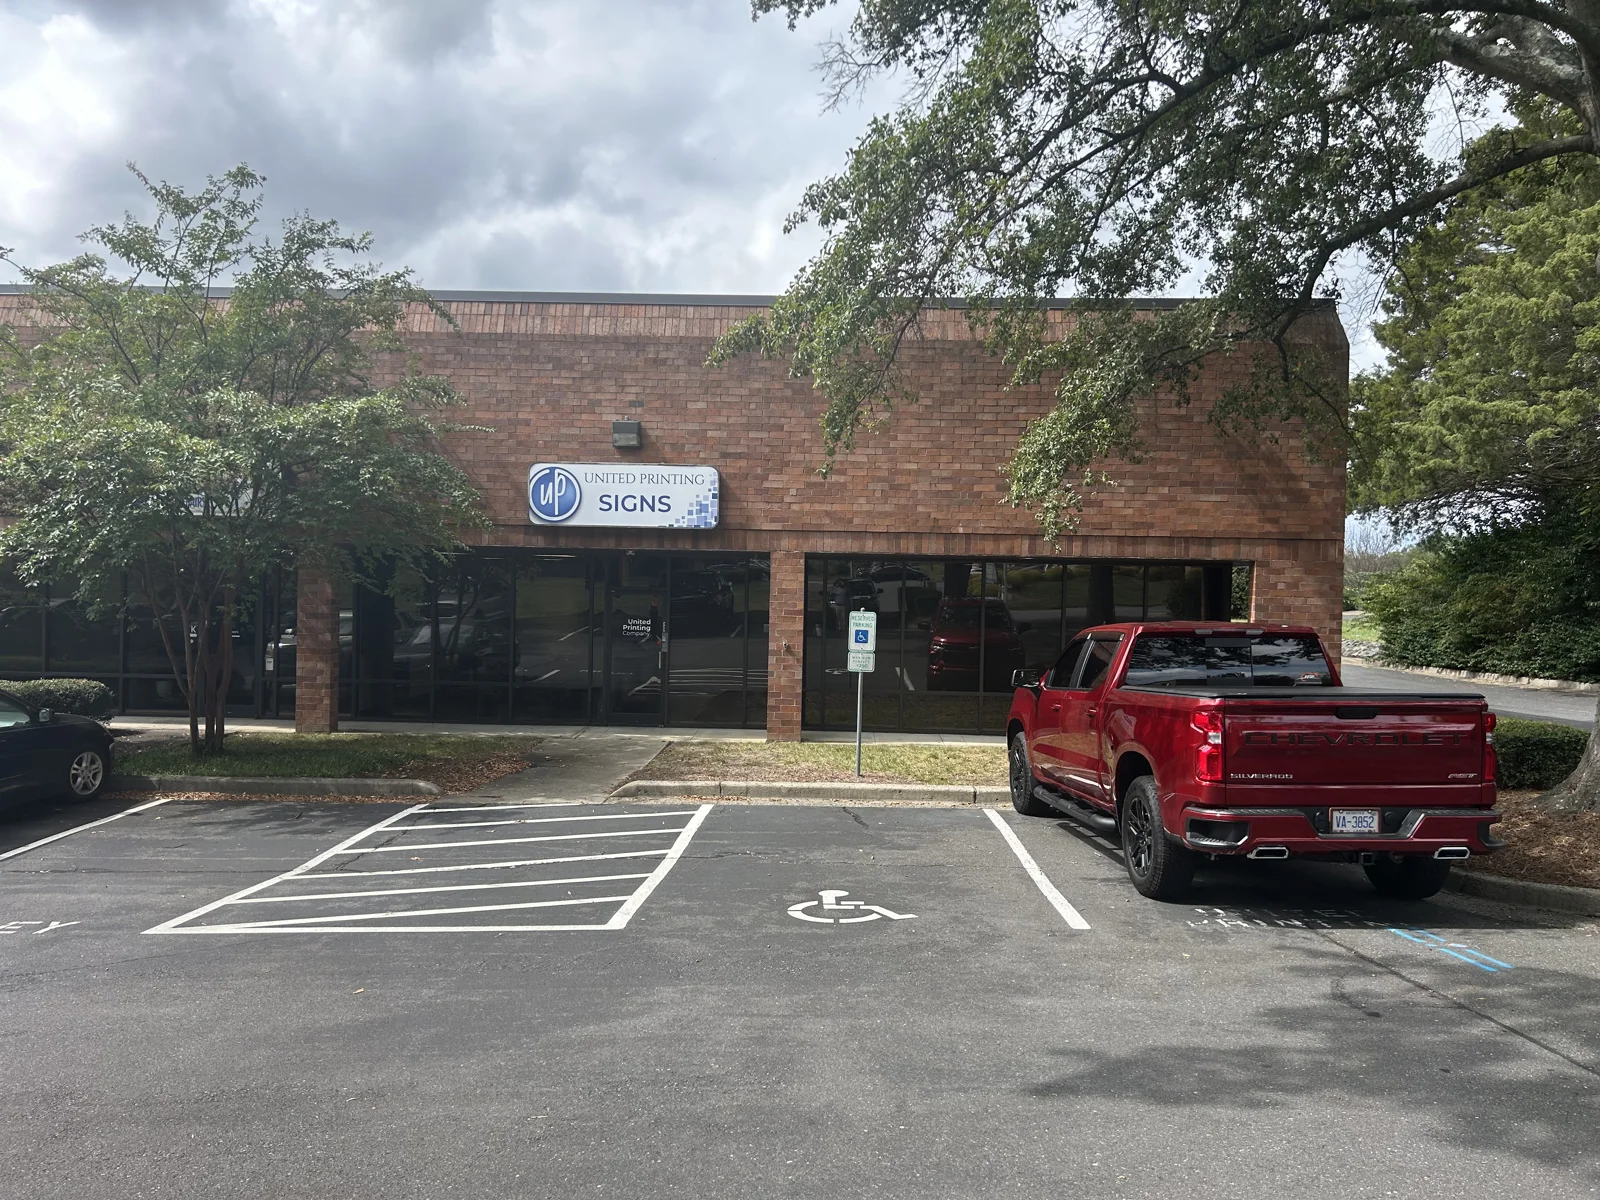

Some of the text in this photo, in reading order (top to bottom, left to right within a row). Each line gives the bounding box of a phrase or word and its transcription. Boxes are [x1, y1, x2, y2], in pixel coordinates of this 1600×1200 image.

[584, 472, 705, 486] UNITED PRINTING
[598, 494, 672, 513] SIGNS
[1245, 732, 1468, 746] CHEVROLET
[1335, 815, 1375, 829] VA-3852
